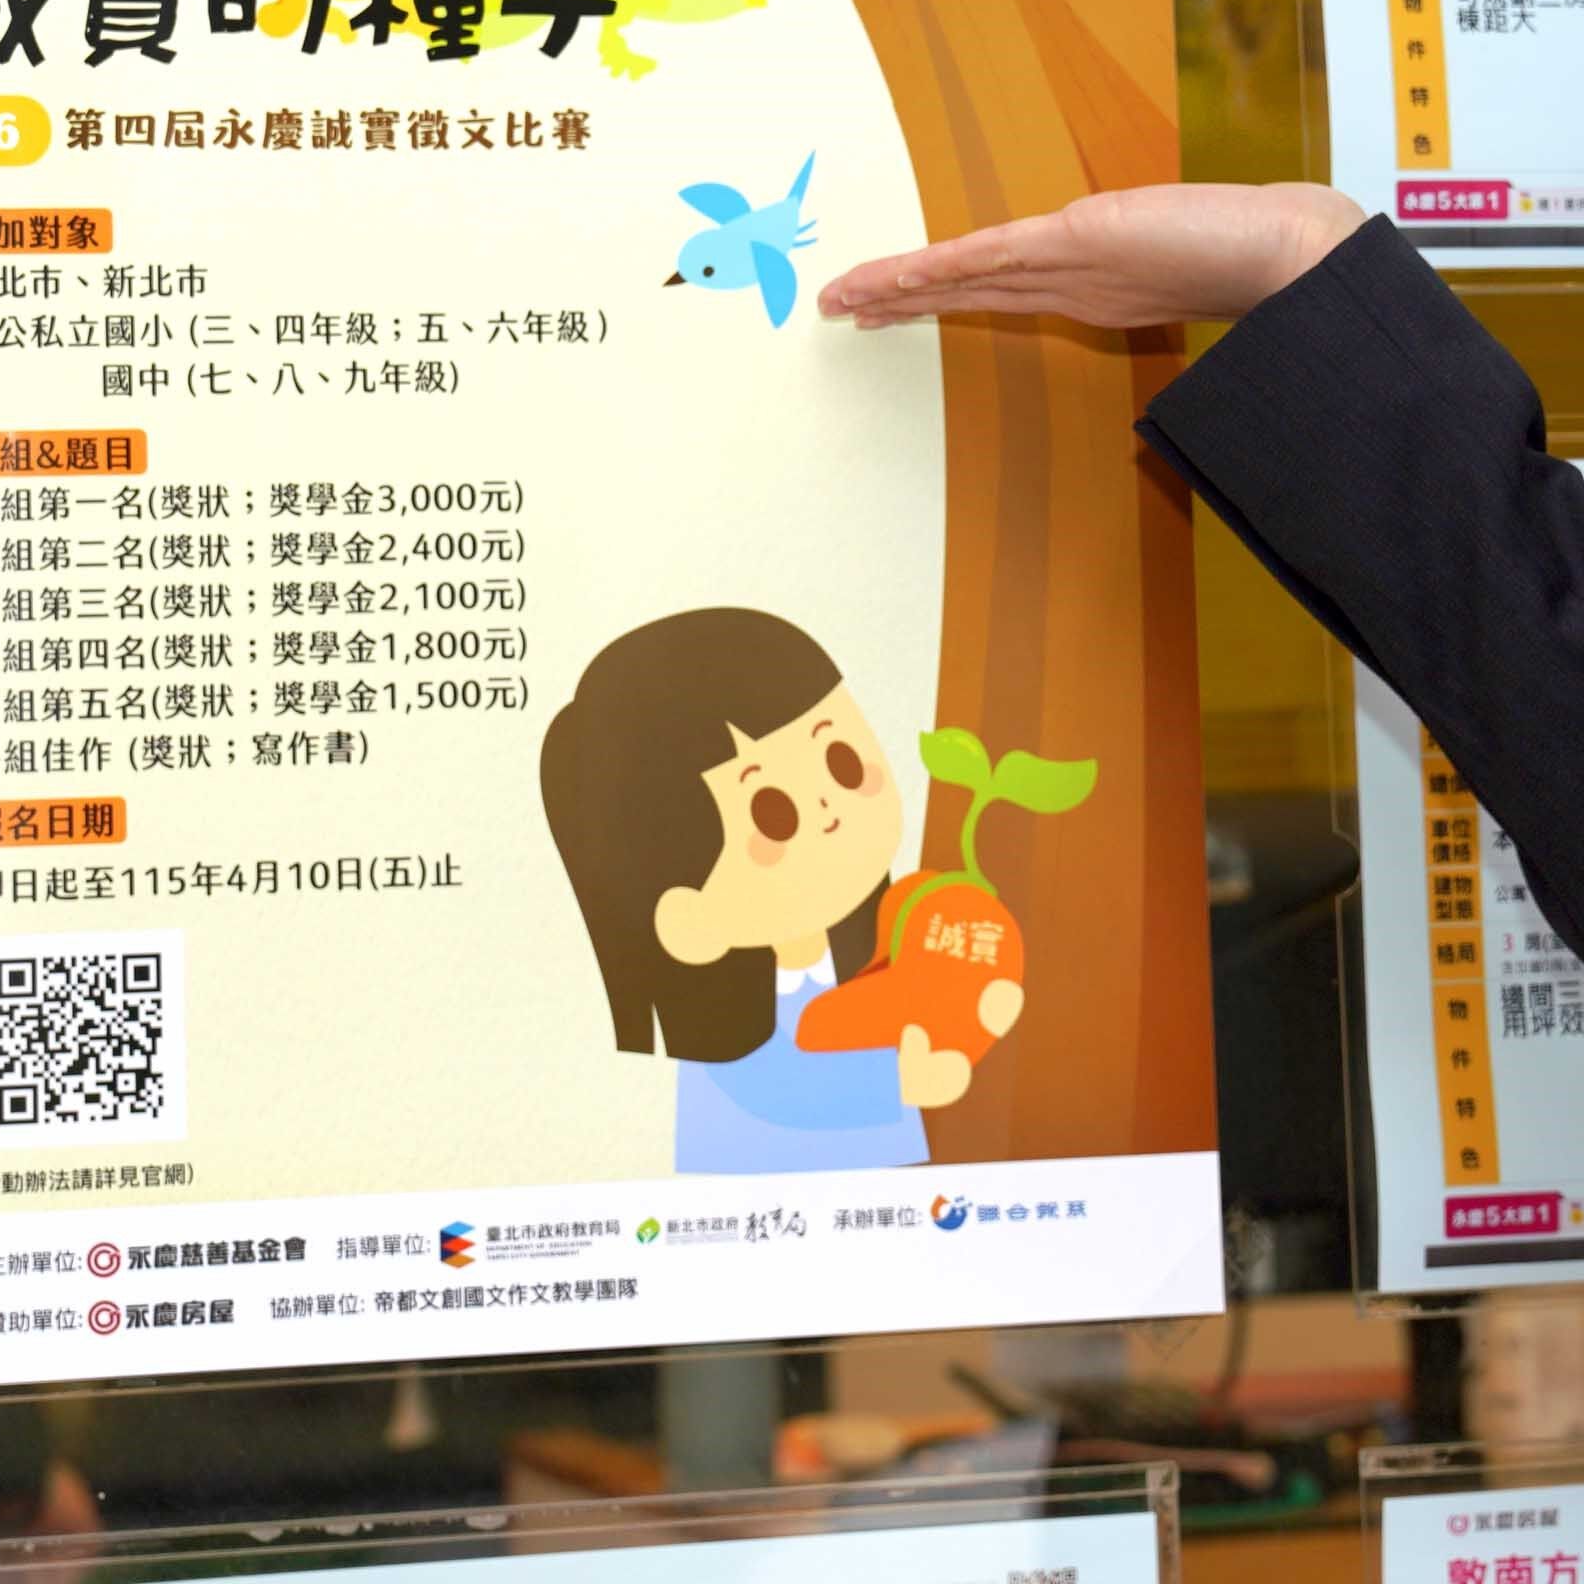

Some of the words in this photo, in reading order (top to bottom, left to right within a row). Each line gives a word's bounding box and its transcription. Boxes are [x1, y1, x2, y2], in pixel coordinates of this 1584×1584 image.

[1456, 8, 1536, 34] 棟距大
[65, 106, 592, 153] 第四屆永慶誠實徵文比賽
[101, 363, 171, 398] 國中
[187, 359, 459, 395] (七、八、九年級)
[129, 731, 369, 771] (獎狀；寫作書)
[924, 913, 1004, 966] 誠實
[128, 1236, 306, 1270] 永慶慈善基金會
[337, 1233, 431, 1259] 指導單位:
[486, 1218, 620, 1243] 臺北市政府教育局
[834, 1206, 921, 1230] 承辦單位:
[125, 1299, 235, 1329] 永慶房屋
[270, 1292, 365, 1319] 協辦單位:
[375, 1276, 638, 1313] 帝都文創國文作文教學團隊
